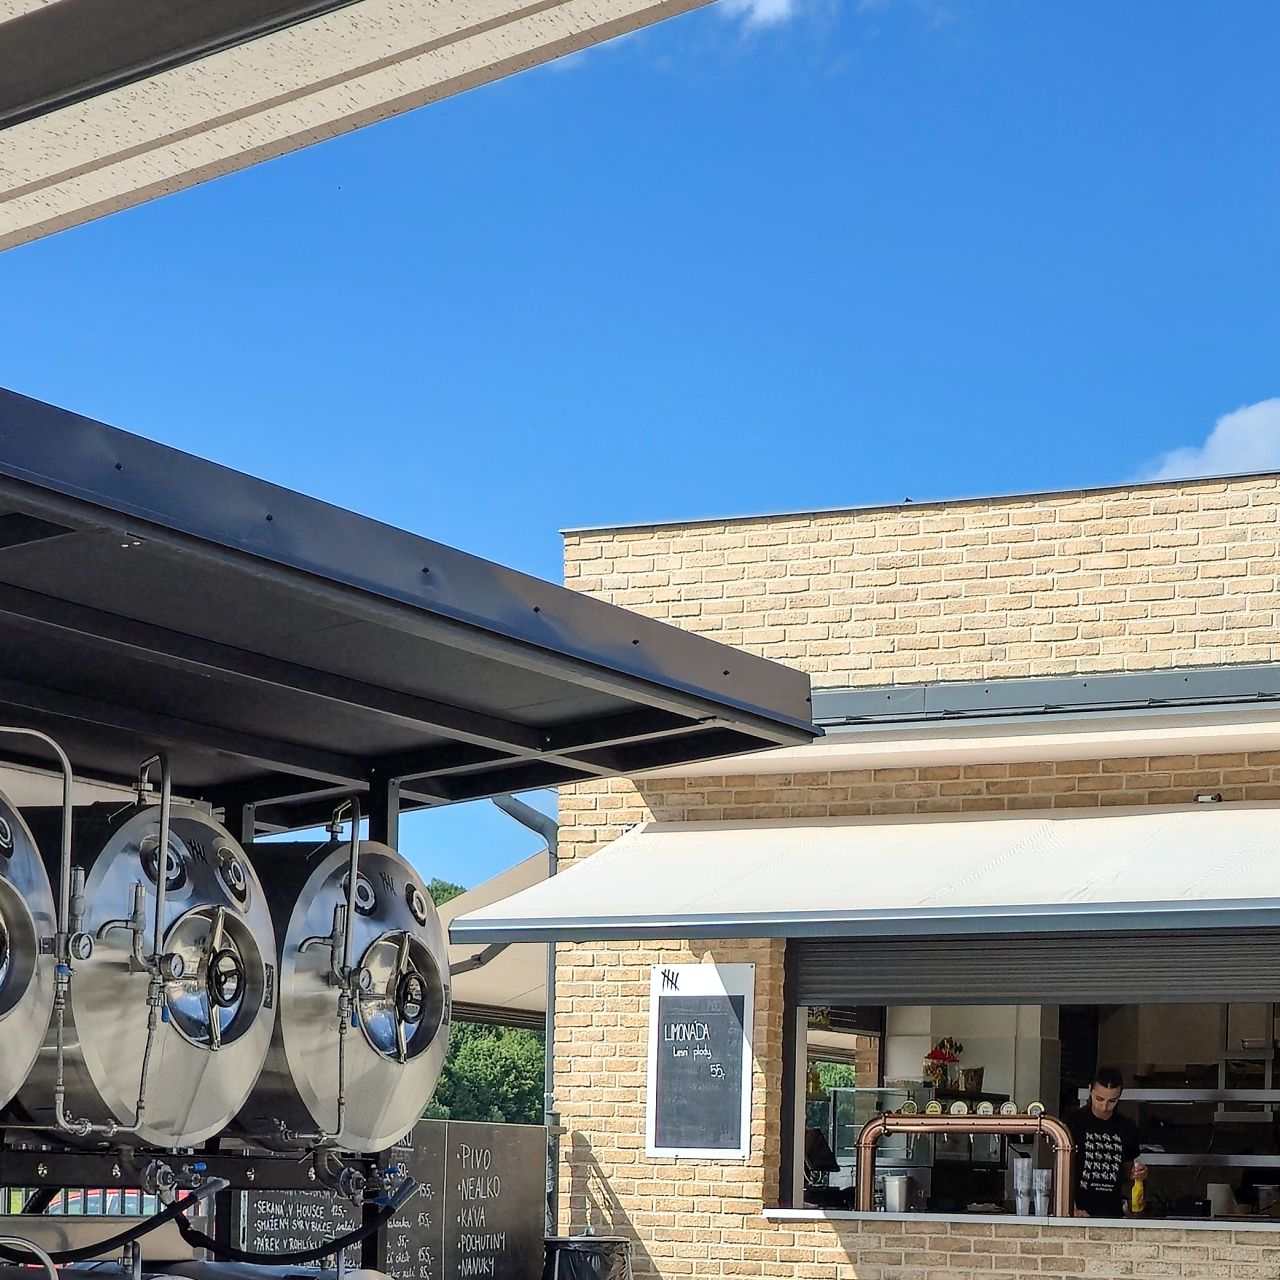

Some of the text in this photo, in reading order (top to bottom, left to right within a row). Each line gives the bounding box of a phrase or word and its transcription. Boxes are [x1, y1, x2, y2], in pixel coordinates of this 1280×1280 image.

[664, 1019, 710, 1041] LIMONÁDA
[673, 1042, 712, 1060] Lesní plody
[460, 1143, 491, 1170] PIVO
[461, 1175, 500, 1200] NEALKO
[296, 1203, 325, 1219] HOUSCE
[461, 1205, 486, 1228] KÁVA
[256, 1233, 280, 1252] PÁREK
[461, 1231, 506, 1253] POCHUTINY
[461, 1257, 495, 1277] NANUKY
